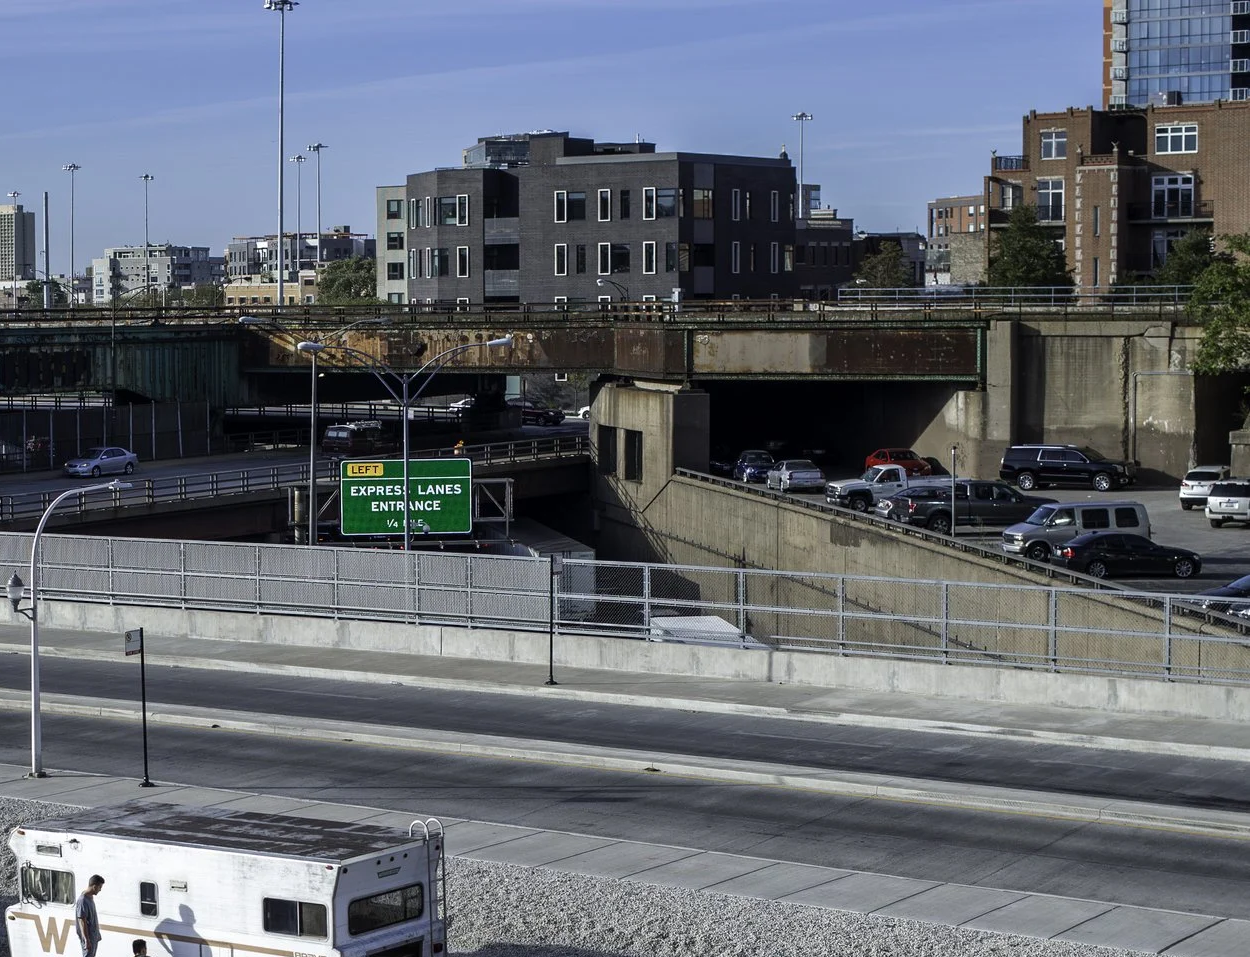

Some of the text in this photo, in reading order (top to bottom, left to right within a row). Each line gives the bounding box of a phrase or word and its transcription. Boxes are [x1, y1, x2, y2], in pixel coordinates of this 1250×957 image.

[351, 465, 379, 474] LEFT
[417, 484, 462, 495] LANES
[34, 914, 72, 955] W
